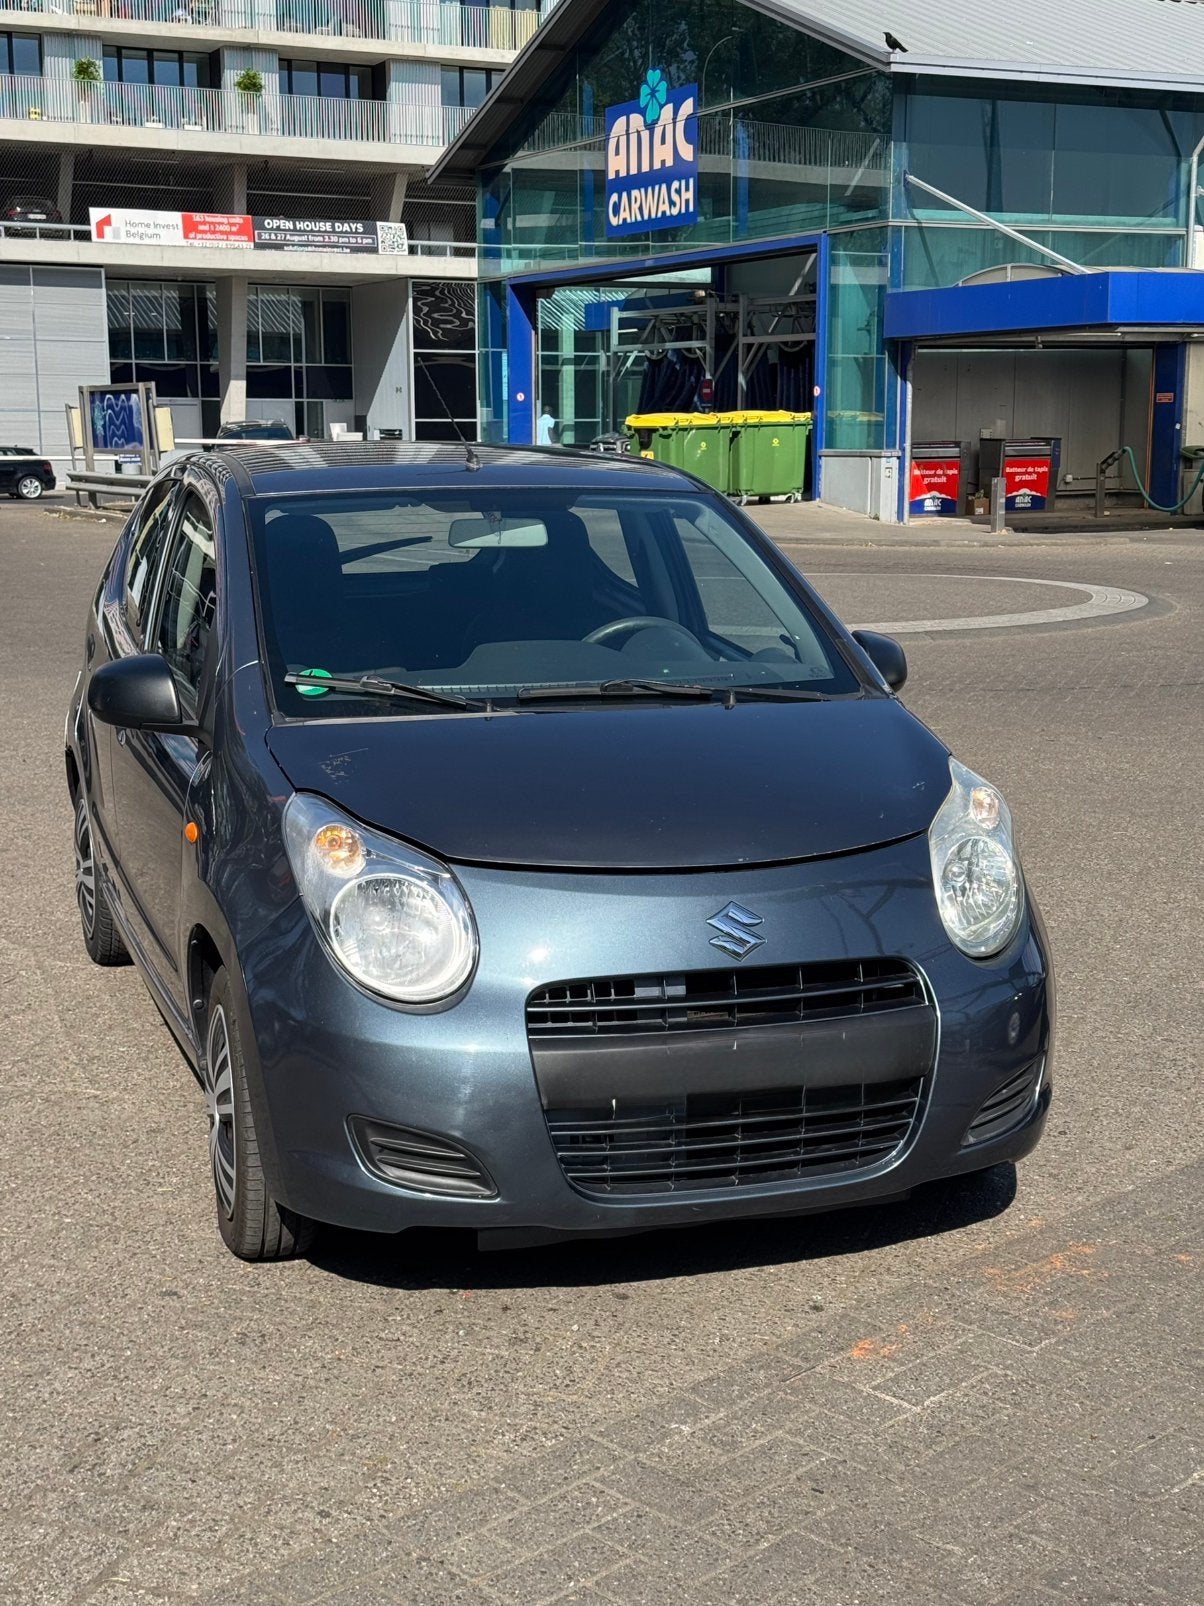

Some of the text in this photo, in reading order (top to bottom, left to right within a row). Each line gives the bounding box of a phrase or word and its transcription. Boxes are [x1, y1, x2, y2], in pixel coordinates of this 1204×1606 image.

[608, 97, 694, 180] ANAC
[608, 177, 694, 227] CARWASH
[125, 220, 179, 231] Home Invest
[264, 219, 364, 232] OPEN HOUSE DAYS
[126, 230, 161, 240] Belgium
[196, 232, 227, 241] productive
[261, 232, 269, 240] 26
[286, 234, 308, 242] August
[923, 476, 947, 485] gratuit
[1014, 473, 1037, 482] gratuit
